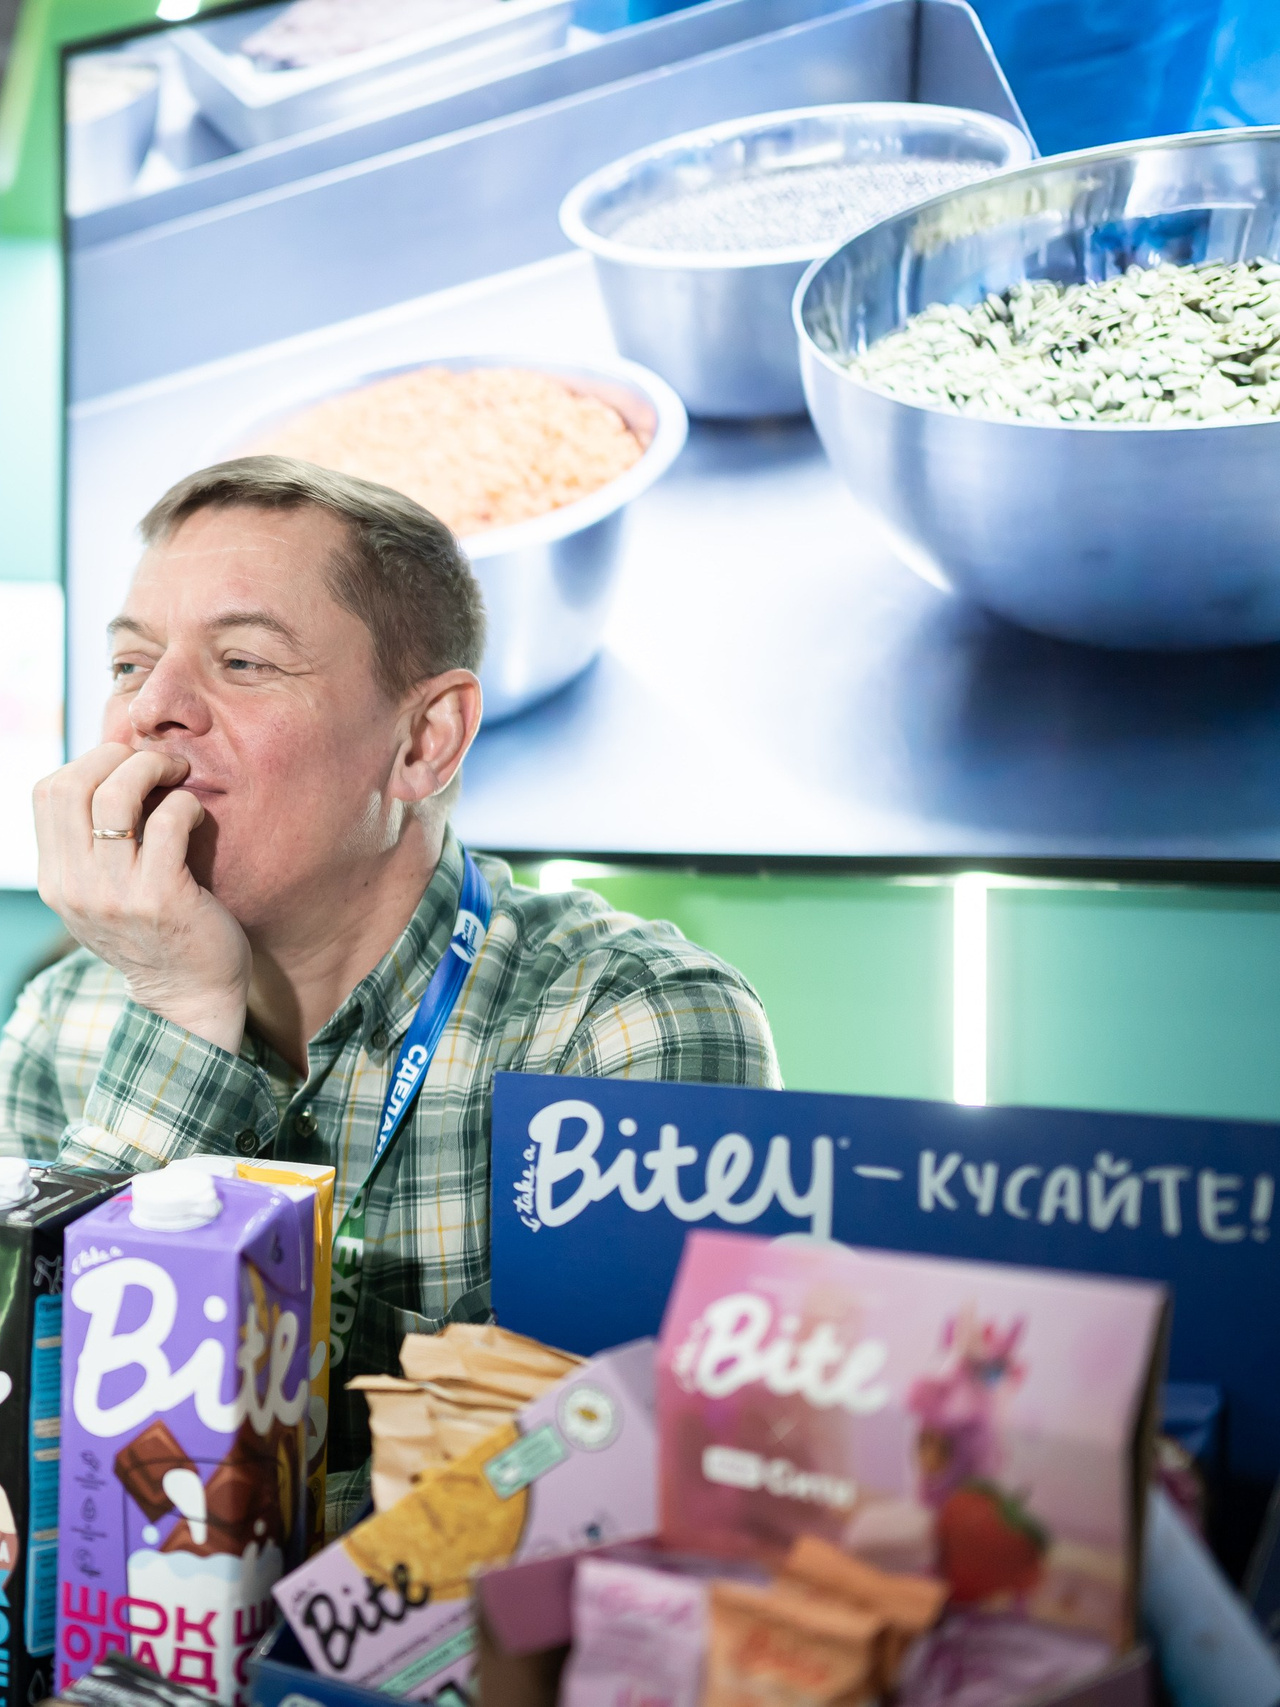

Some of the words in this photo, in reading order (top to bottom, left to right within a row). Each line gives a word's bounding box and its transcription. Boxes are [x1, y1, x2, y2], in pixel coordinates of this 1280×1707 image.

[513, 1169, 535, 1214] take
[528, 1099, 848, 1250] Bitey
[919, 1149, 1275, 1244] КУСАЙТЕ!
[71, 1257, 310, 1438] Bite
[694, 1292, 892, 1416] Bite
[302, 1562, 431, 1671] Bite
